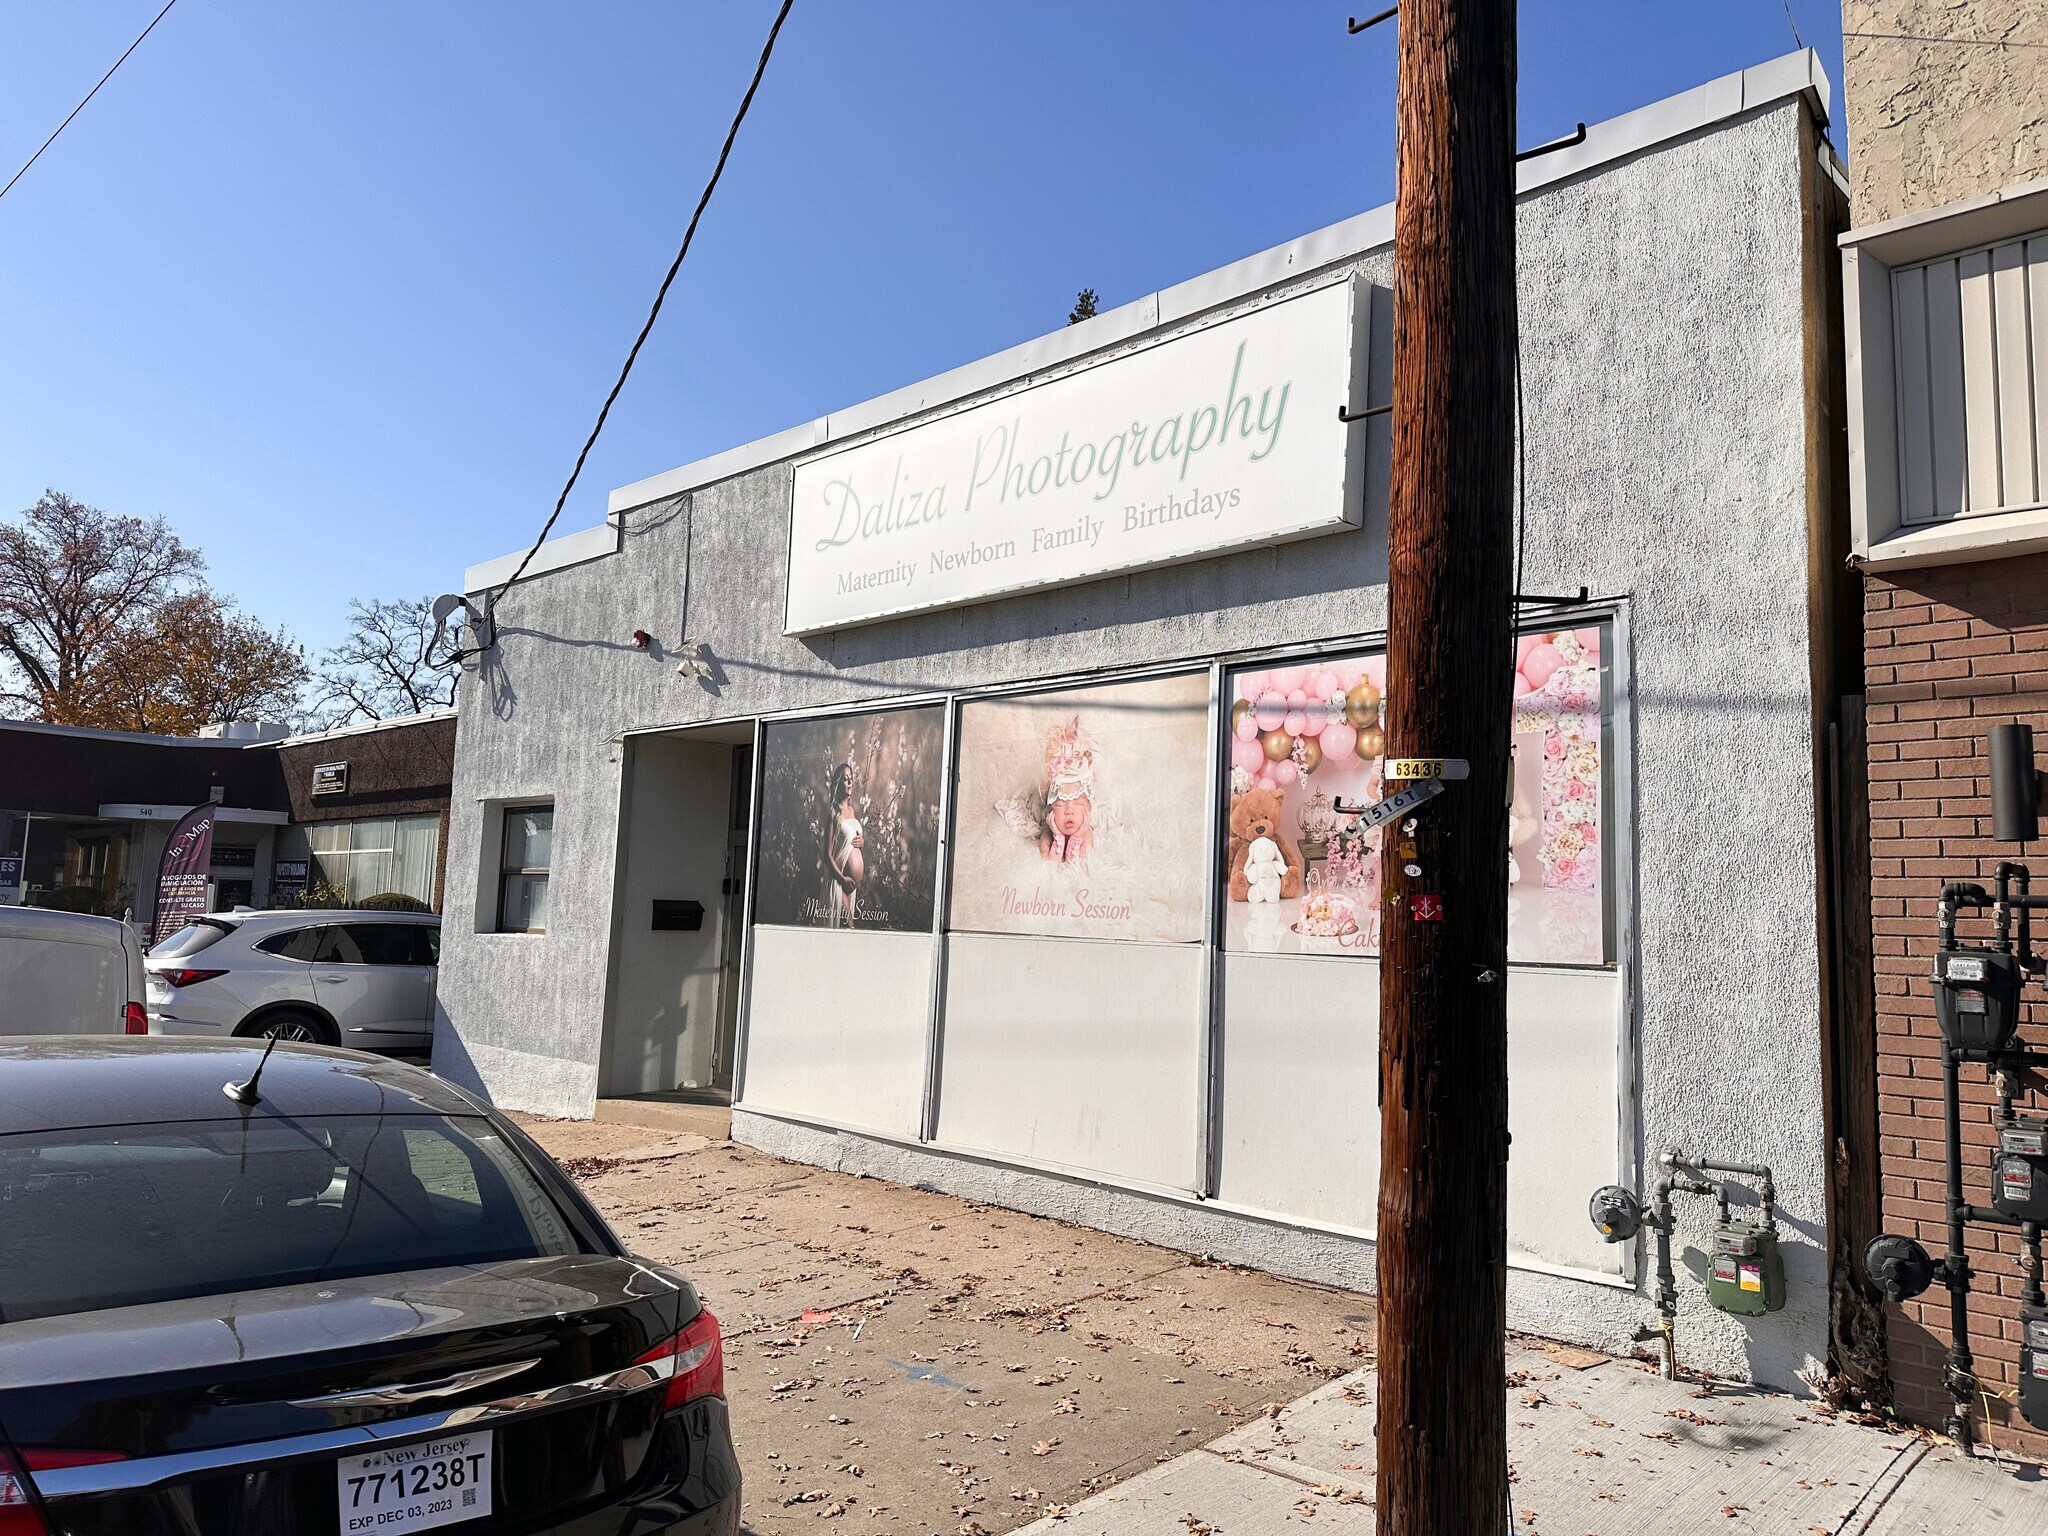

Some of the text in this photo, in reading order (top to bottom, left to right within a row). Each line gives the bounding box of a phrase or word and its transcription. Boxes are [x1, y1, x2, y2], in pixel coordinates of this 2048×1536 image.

[815, 338, 1293, 552] Daliza Photography
[836, 487, 1241, 596] Maternity Newborn Family Birthdays
[1396, 763, 1442, 776] 63436
[140, 808, 153, 816] 540
[1361, 790, 1416, 827] 1516T
[805, 896, 889, 925] Maternity Session
[1002, 885, 1131, 920] Newborn Session
[1337, 917, 1381, 948] Cak
[383, 1449, 418, 1466] New
[422, 1439, 470, 1455] Jersey
[347, 1453, 486, 1508] 771238T
[349, 1499, 453, 1530] EXP DEC 03, 2023
